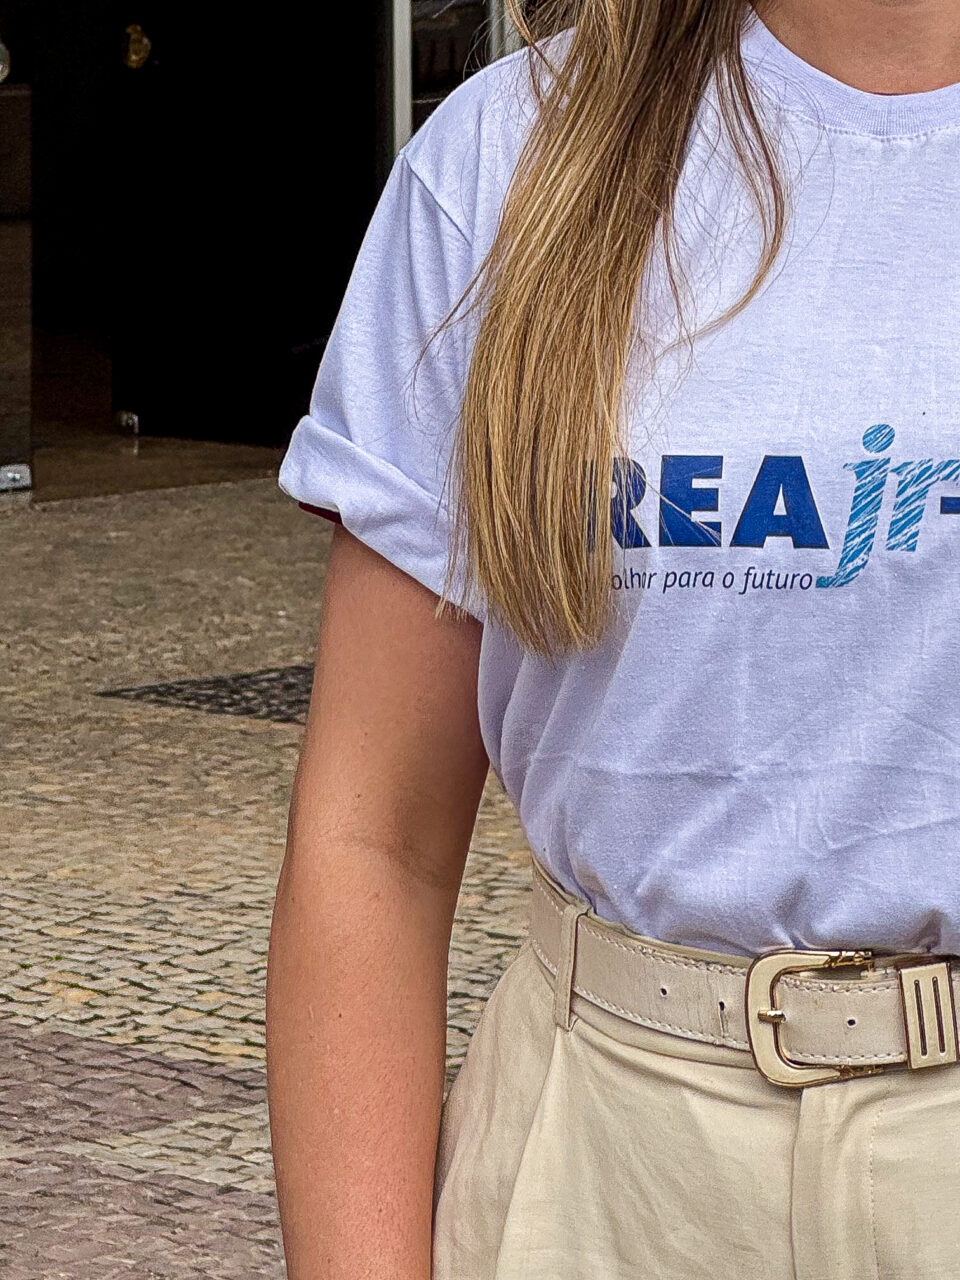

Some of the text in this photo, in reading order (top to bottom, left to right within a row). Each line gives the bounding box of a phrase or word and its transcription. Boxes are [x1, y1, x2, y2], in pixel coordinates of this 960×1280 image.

[662, 570, 714, 594] para
[722, 572, 734, 589] o
[738, 566, 813, 595] futuro
